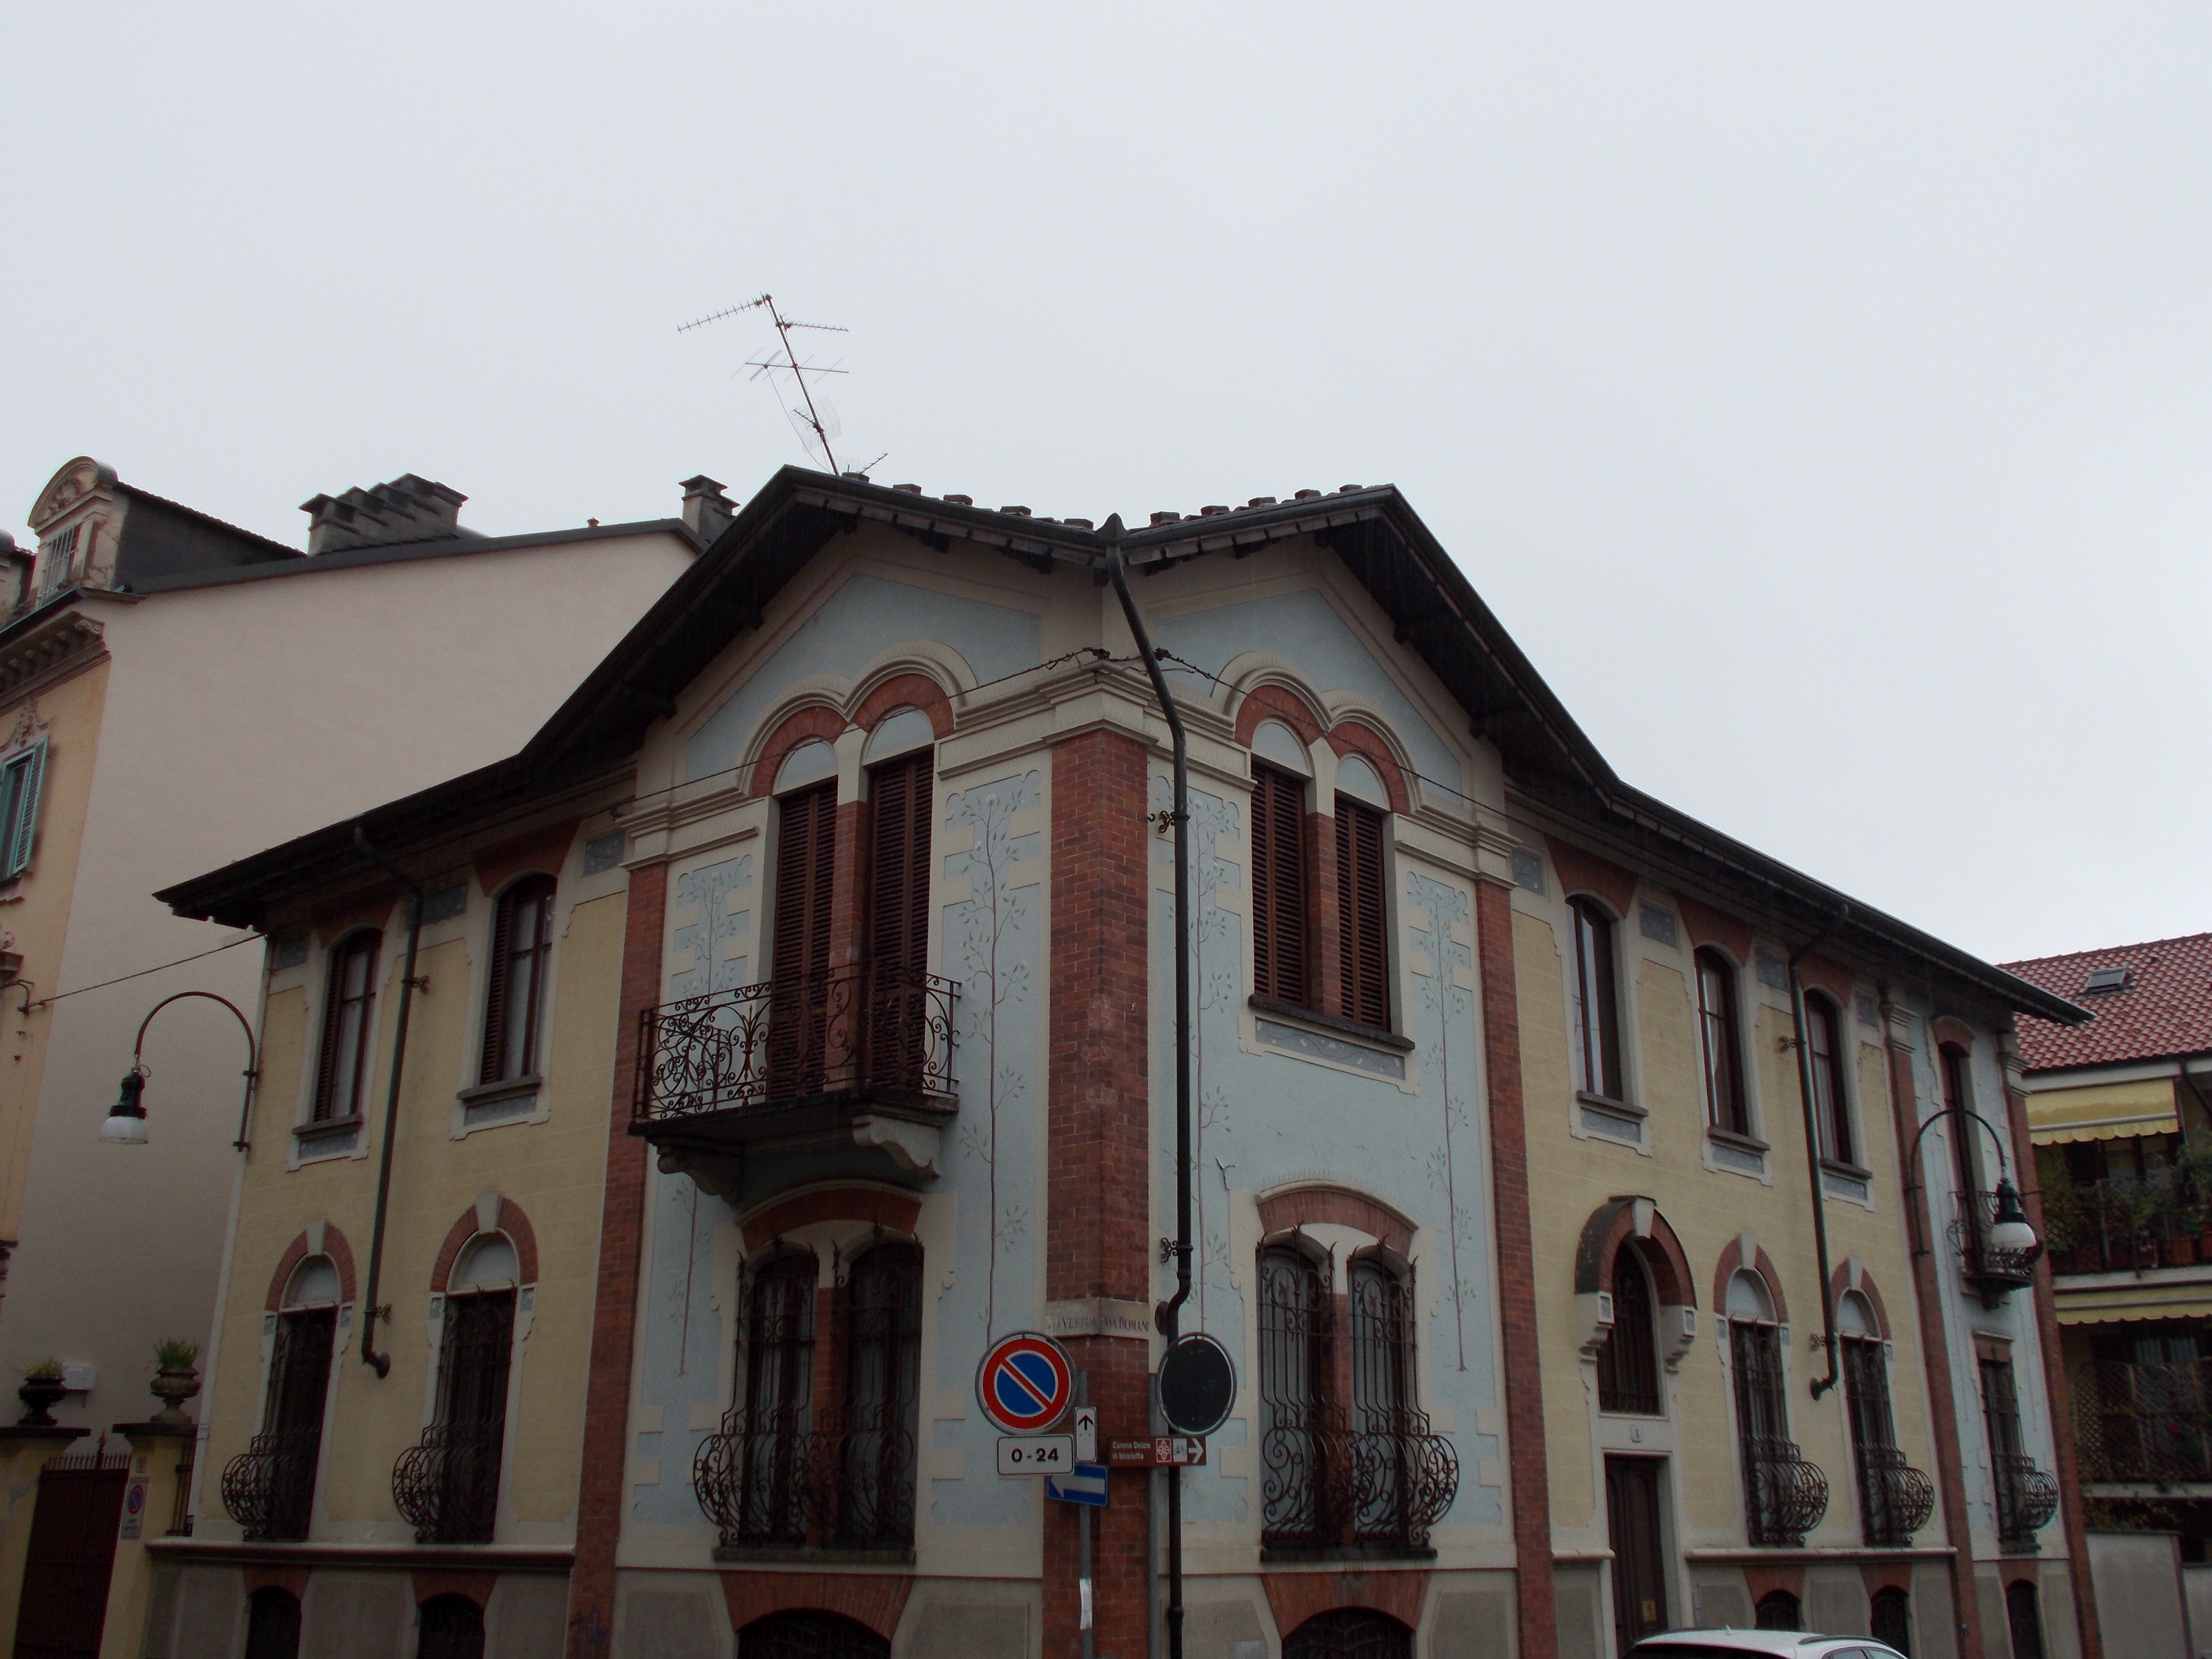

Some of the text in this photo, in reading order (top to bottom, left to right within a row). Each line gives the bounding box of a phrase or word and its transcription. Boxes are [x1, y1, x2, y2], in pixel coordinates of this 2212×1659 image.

[1100, 1316, 1149, 1331] VIA ROMANI
[1112, 1440, 1132, 1449] Corona
